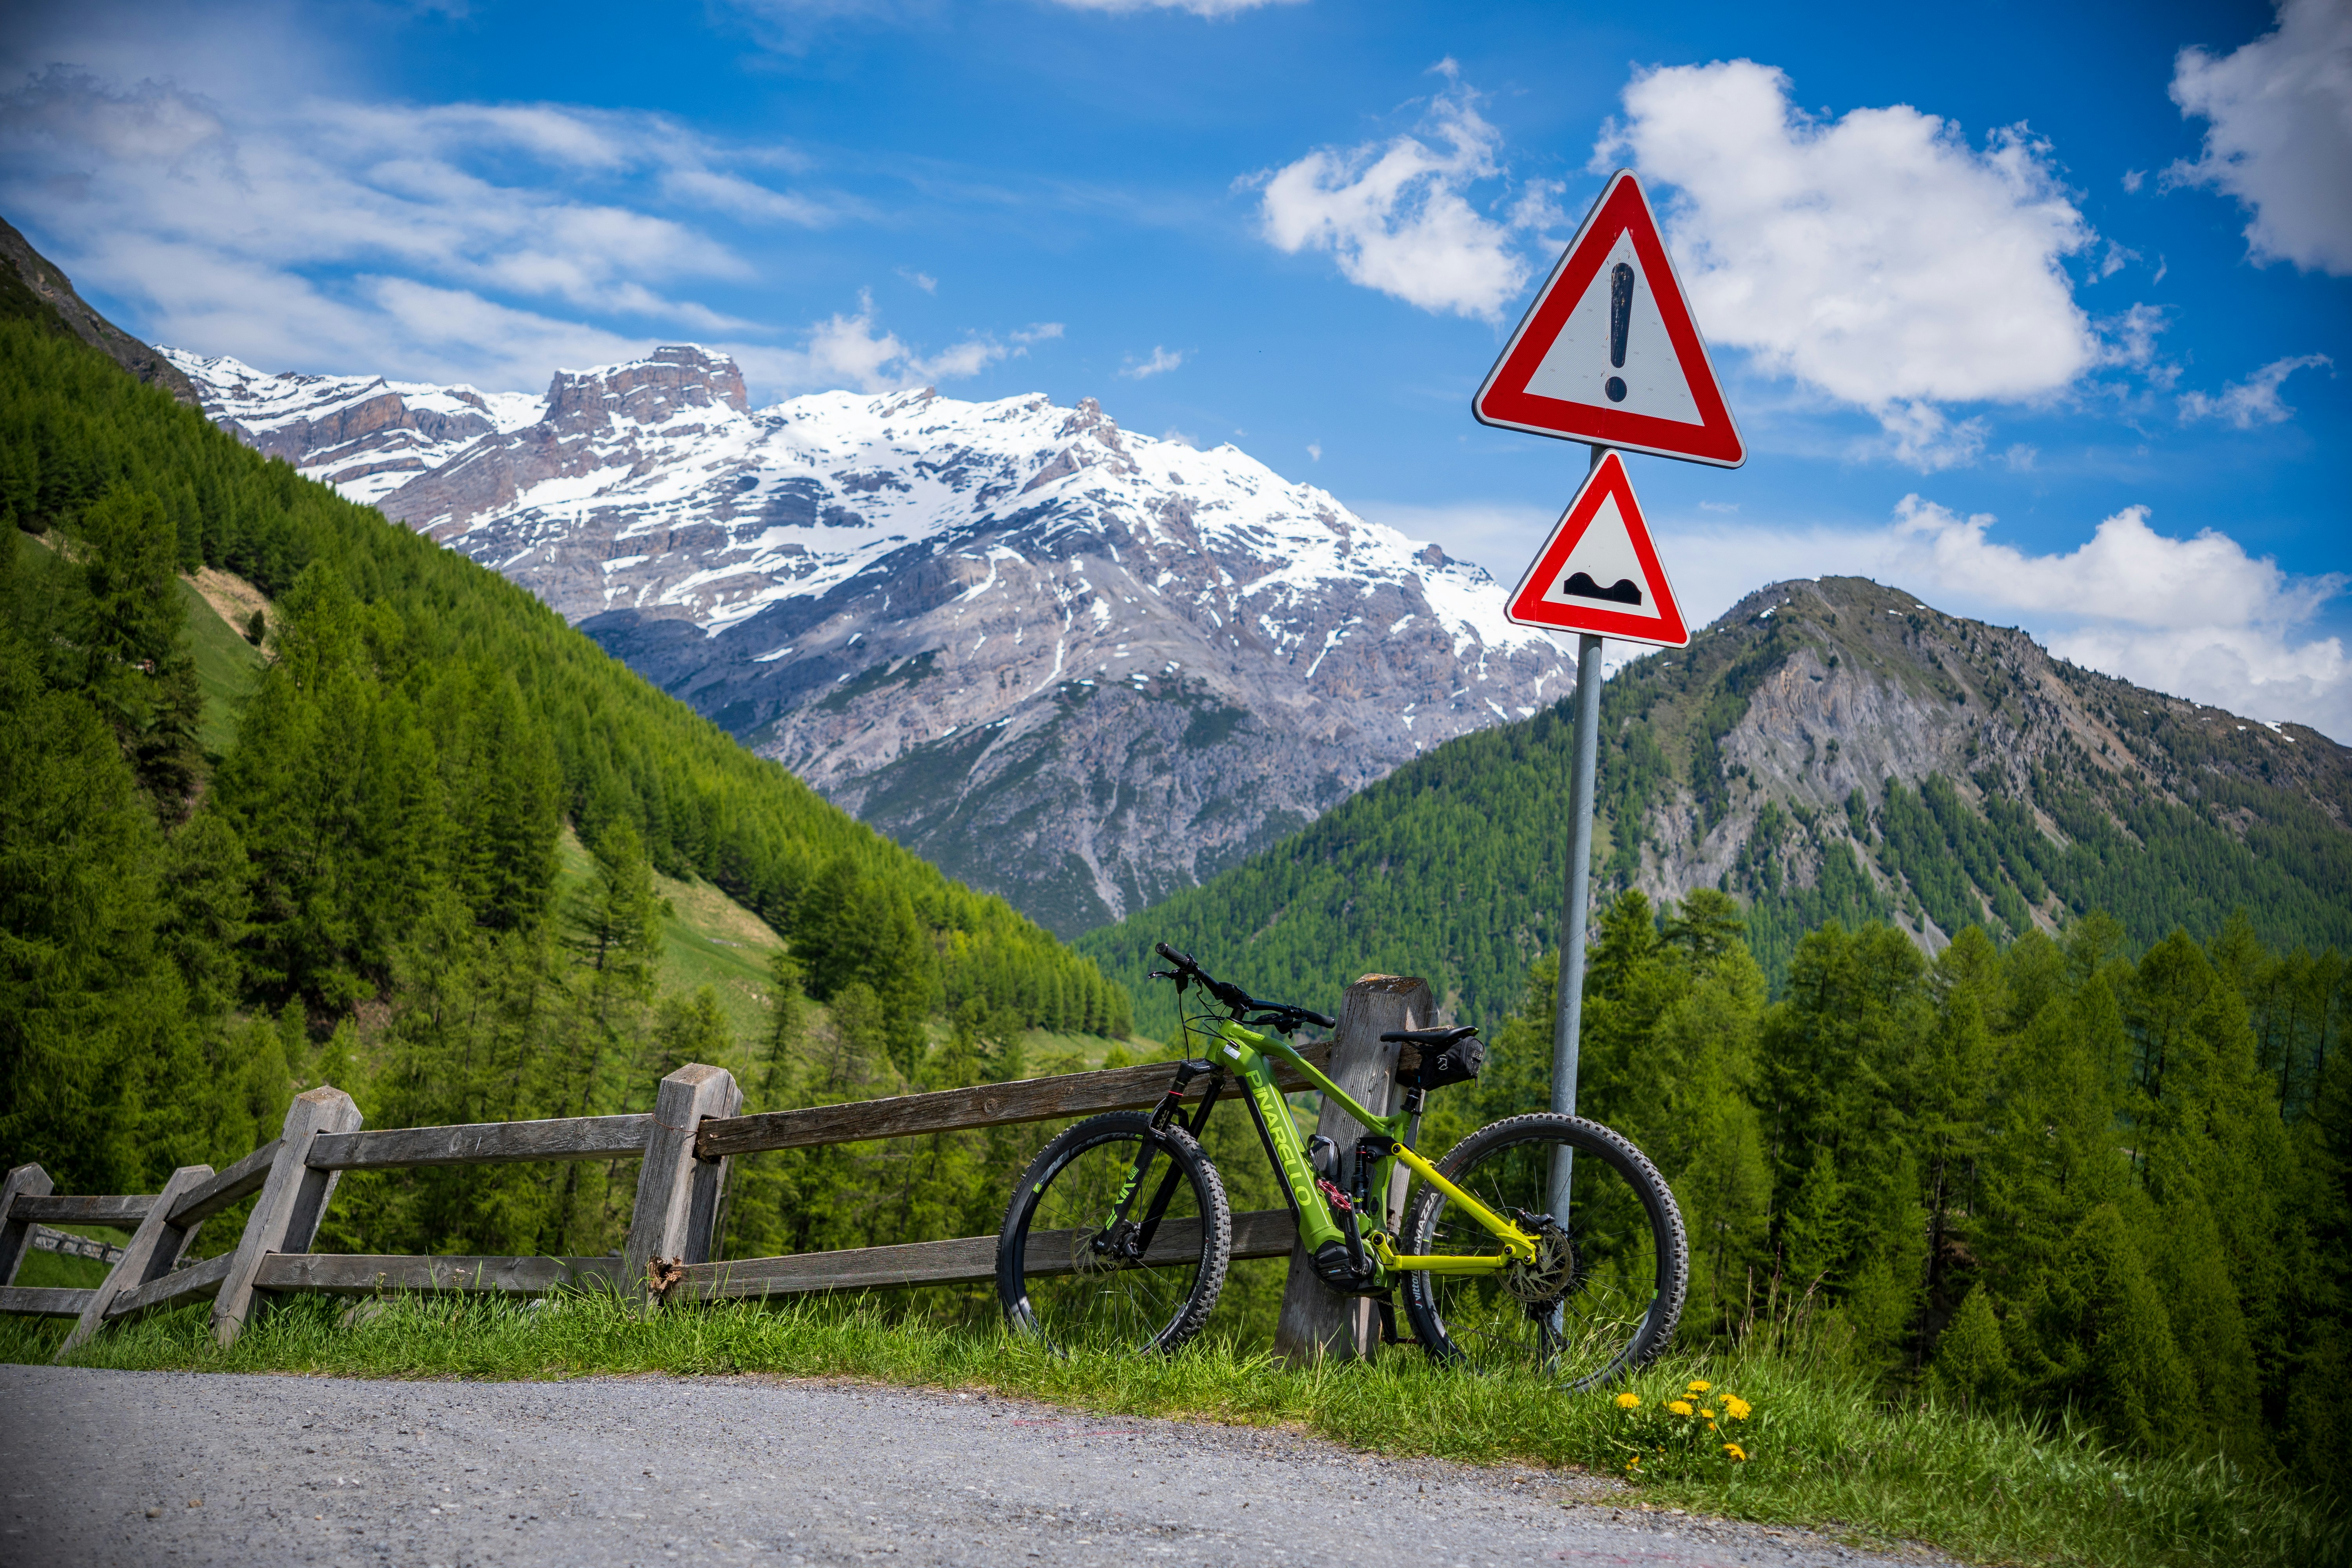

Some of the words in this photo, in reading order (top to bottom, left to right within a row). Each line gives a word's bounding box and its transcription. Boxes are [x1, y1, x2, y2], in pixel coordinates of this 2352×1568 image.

[1245, 1069, 1311, 1206] PINARELLO
[1414, 1192, 1438, 1255] e-MAZZA
[1455, 1194, 1496, 1227] PINARELLO
